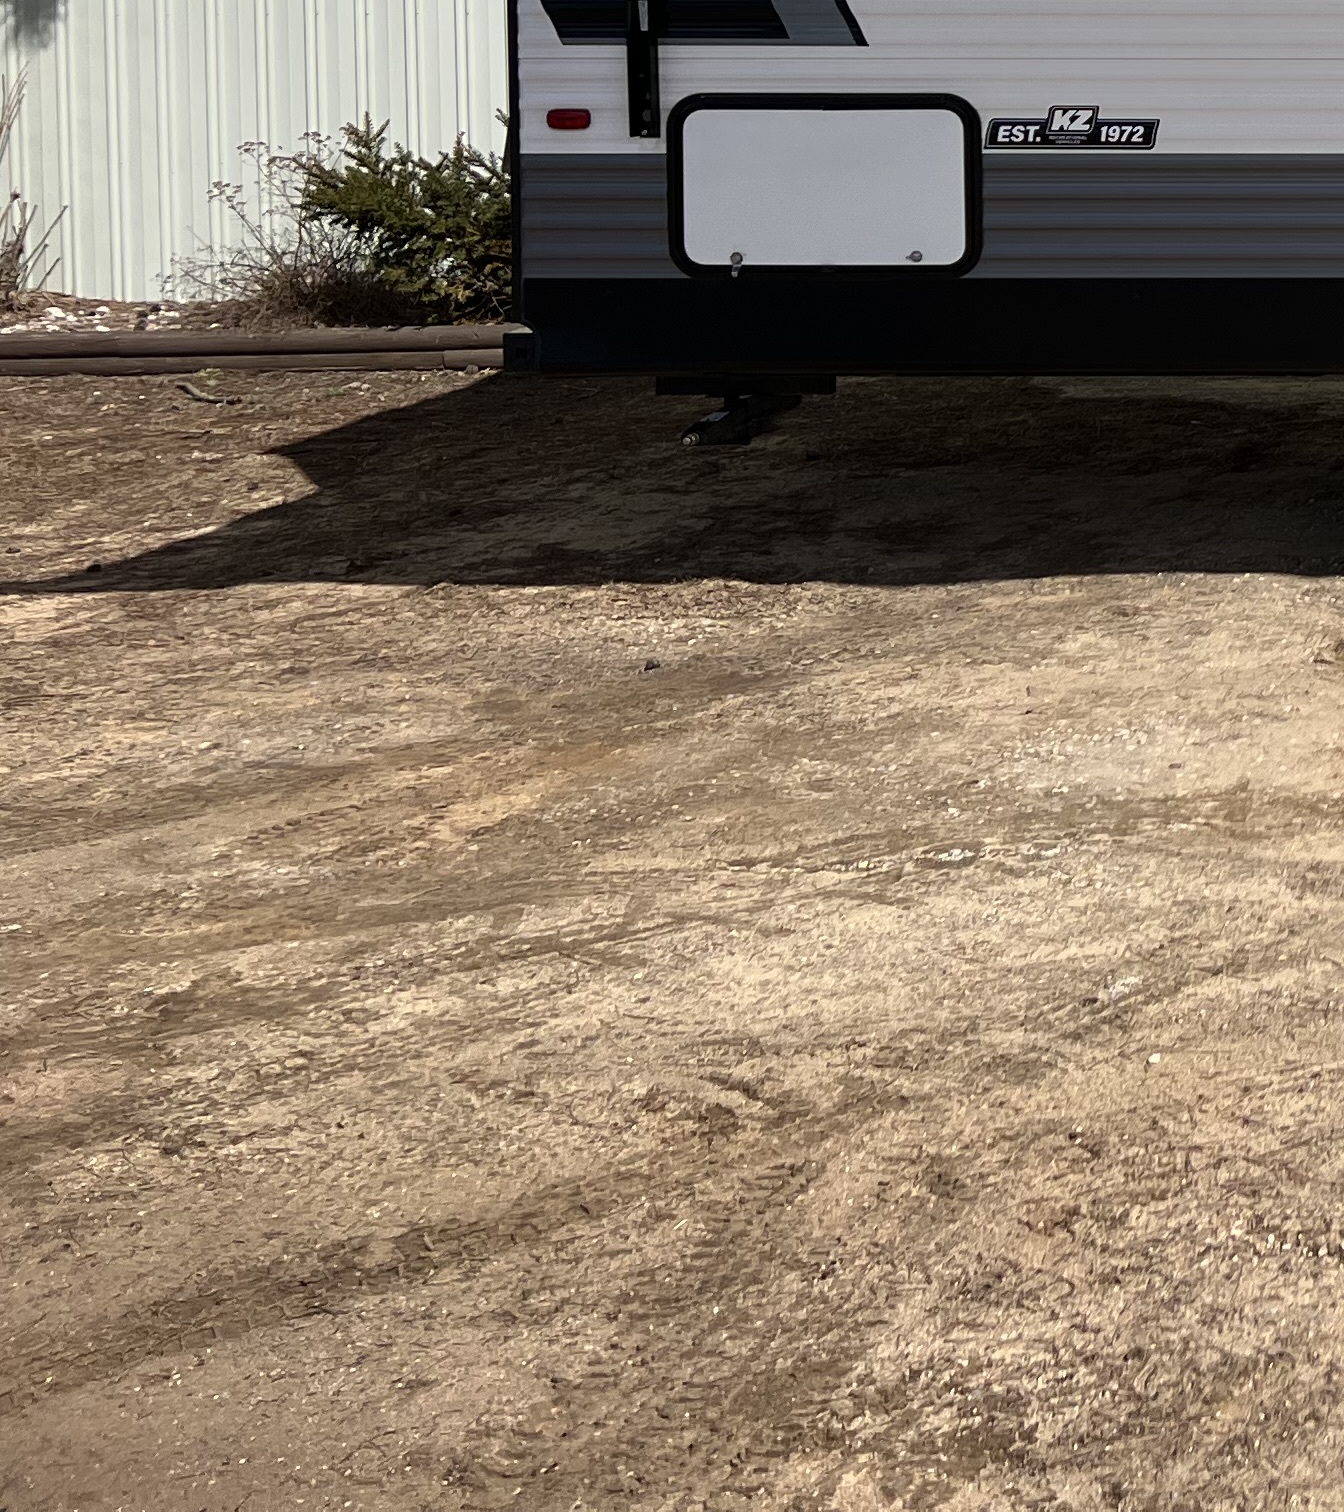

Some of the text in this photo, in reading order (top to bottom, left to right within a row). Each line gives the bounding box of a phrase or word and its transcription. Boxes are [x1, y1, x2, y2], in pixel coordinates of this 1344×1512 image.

[996, 109, 1145, 143] EST. KZ 1972
